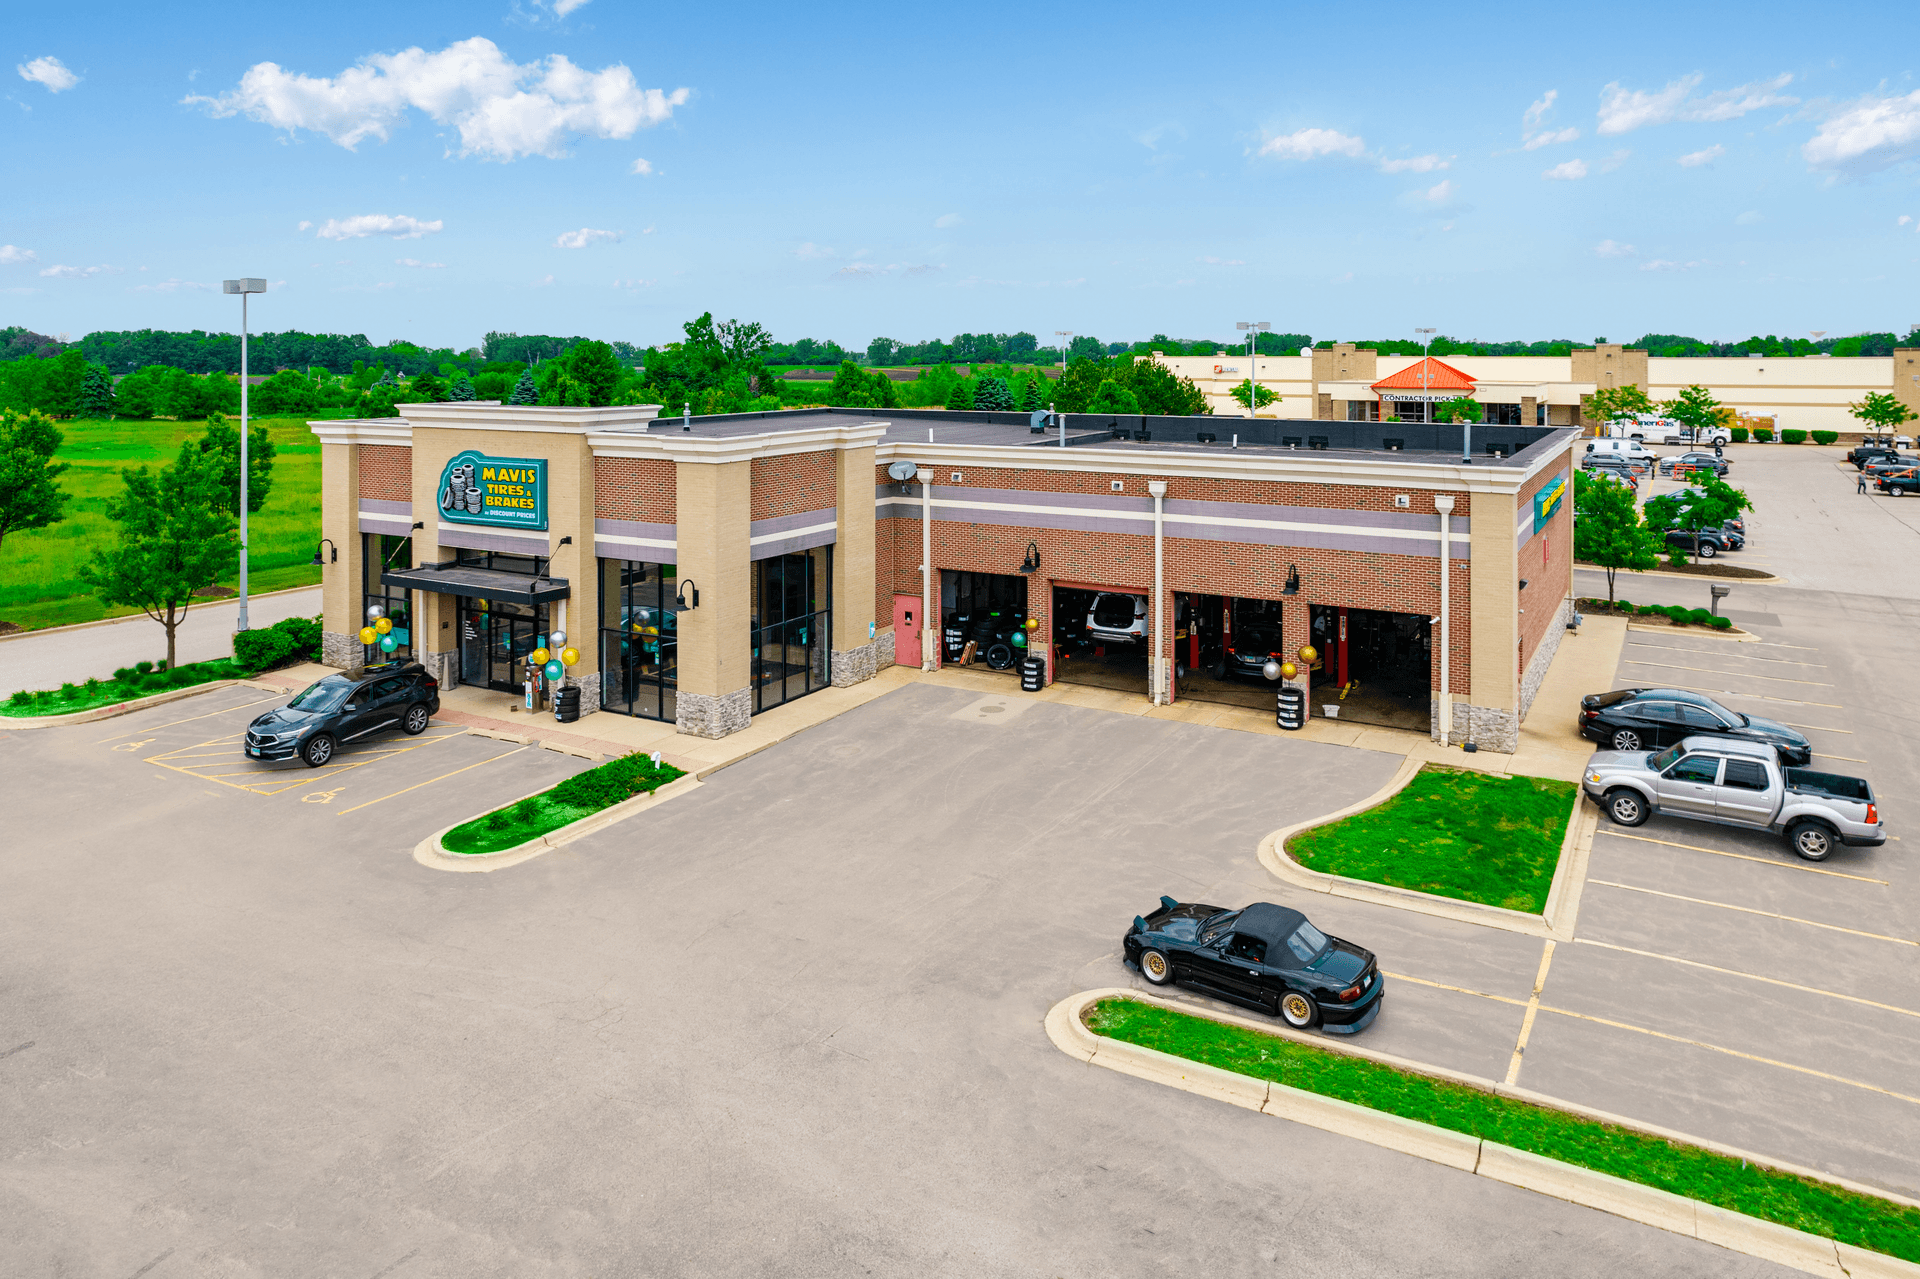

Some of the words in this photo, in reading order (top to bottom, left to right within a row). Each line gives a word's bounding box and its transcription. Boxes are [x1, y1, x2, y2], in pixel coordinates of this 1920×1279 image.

[1631, 419, 1674, 427] AmeriGas
[482, 467, 536, 484] MAVIS
[486, 483, 525, 496] TIRES
[526, 489, 532, 497] &
[485, 495, 535, 510] BRAKES
[490, 510, 516, 518] DISCOUNT
